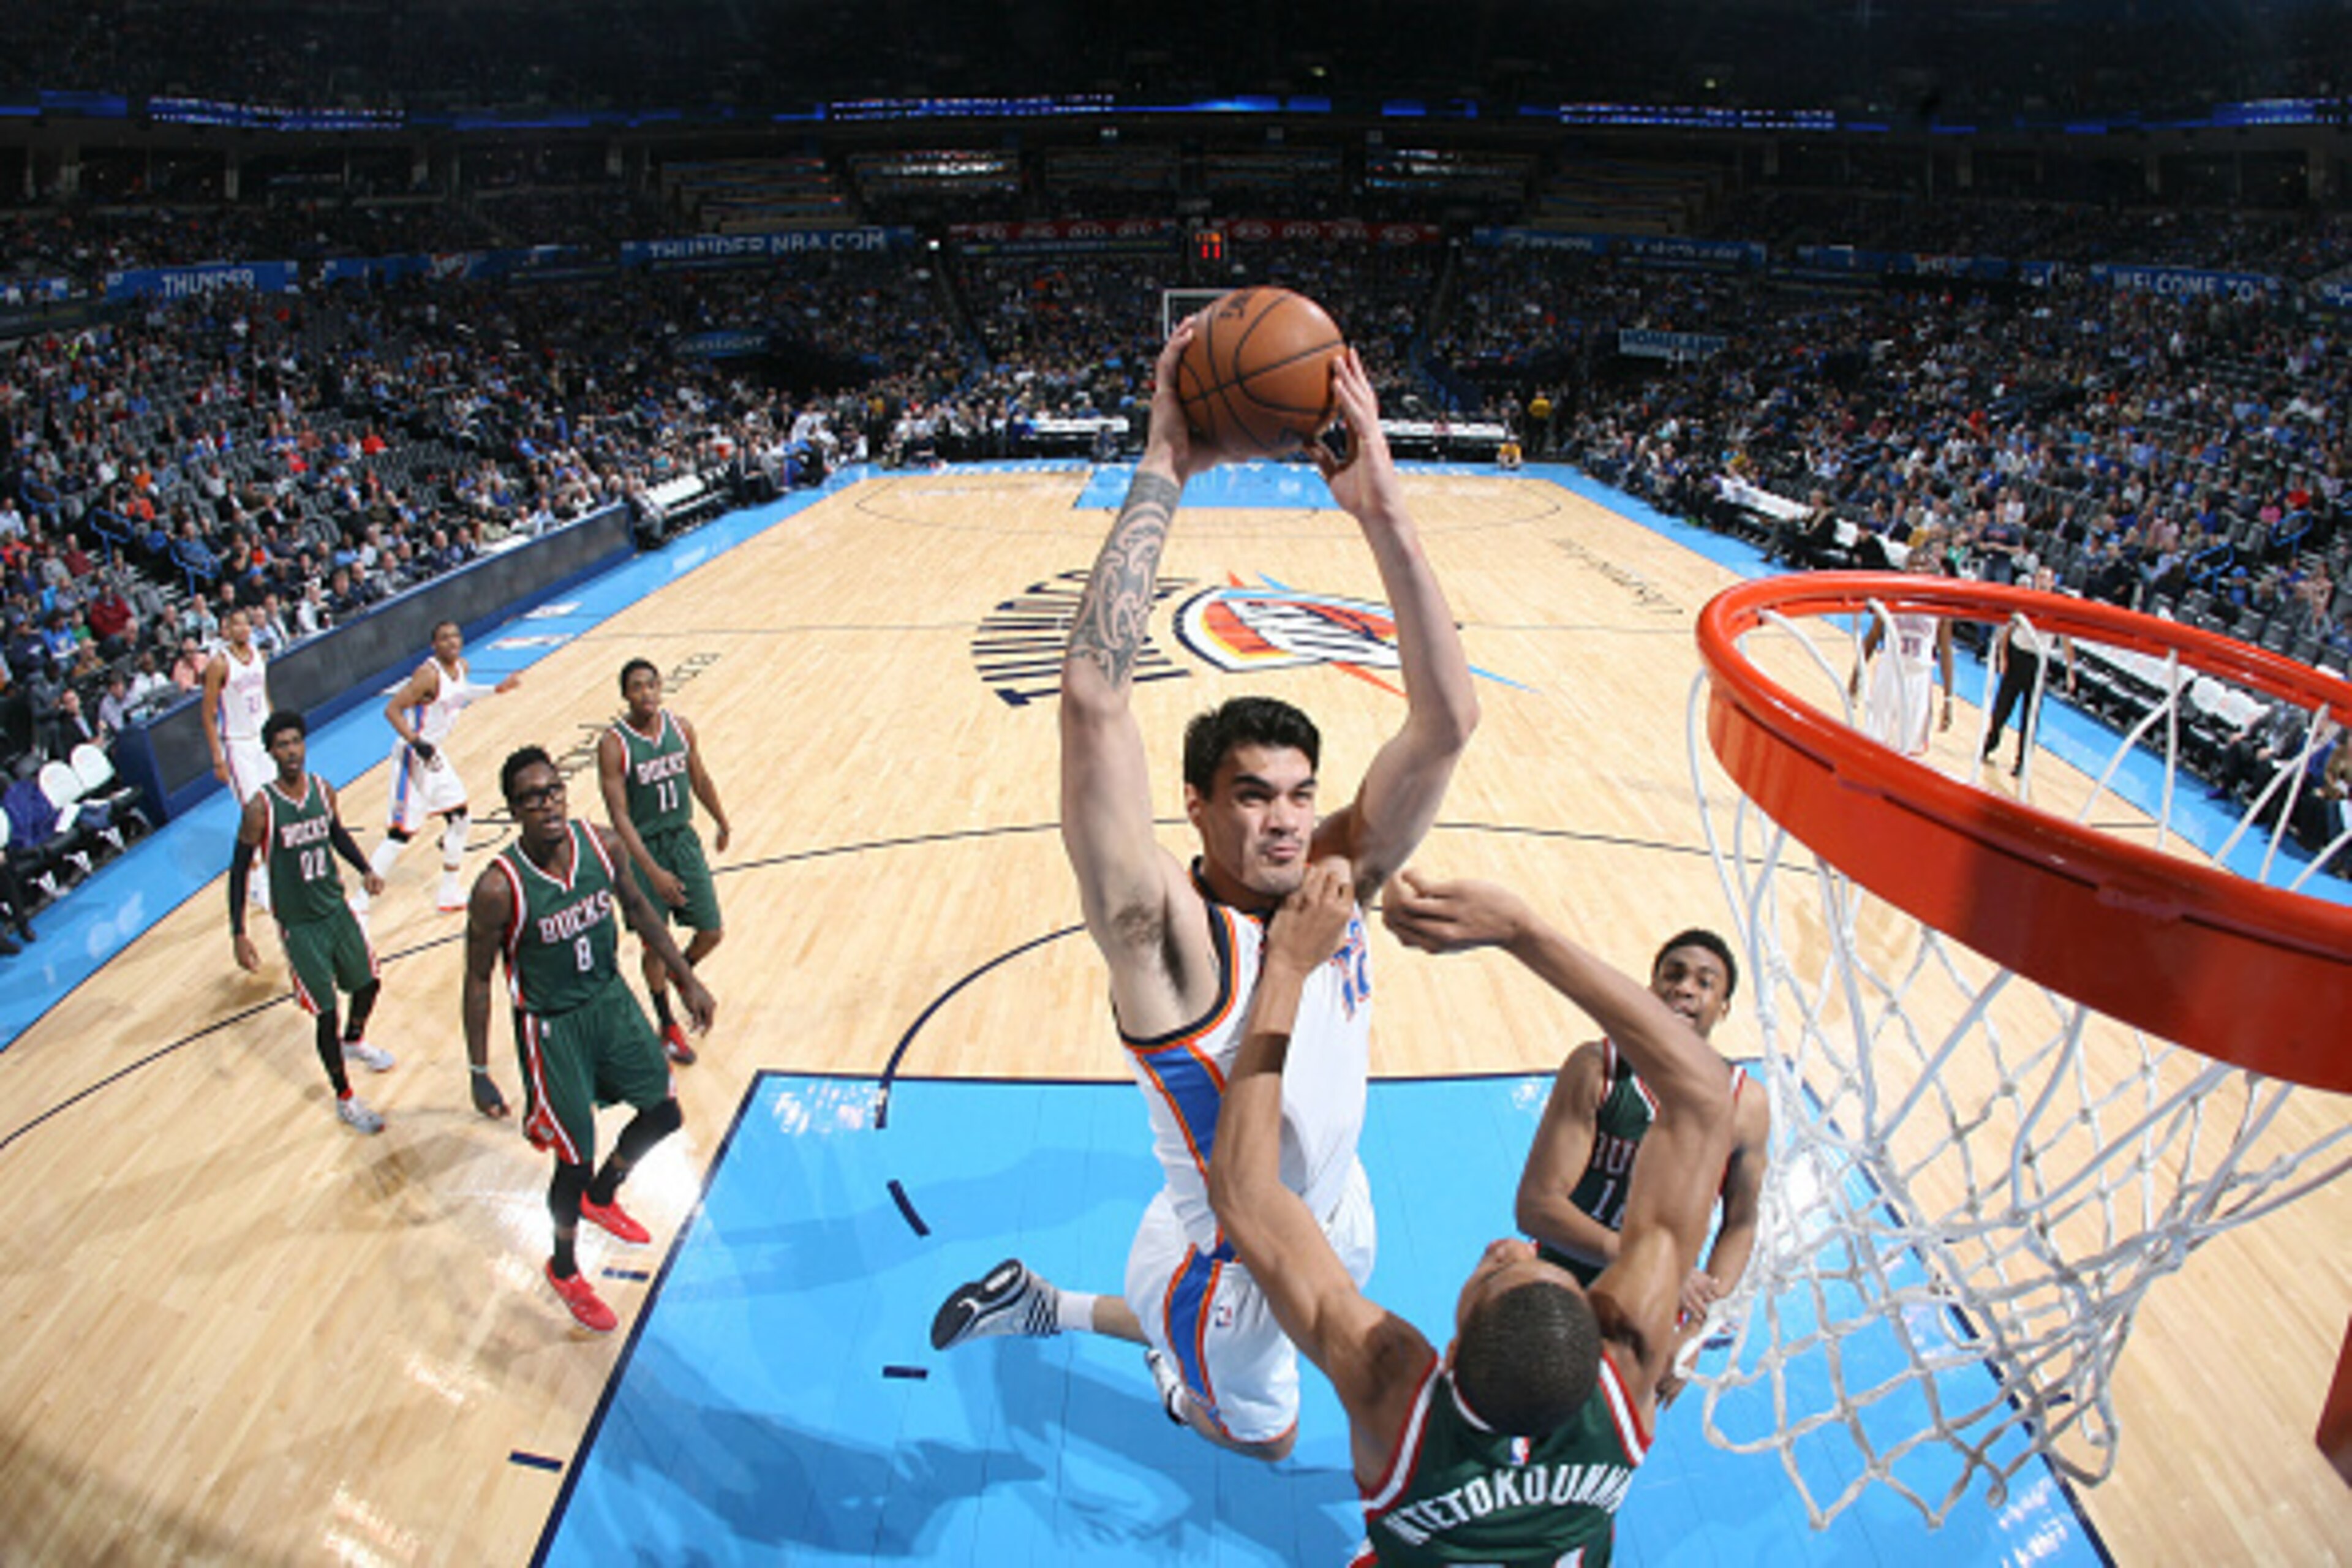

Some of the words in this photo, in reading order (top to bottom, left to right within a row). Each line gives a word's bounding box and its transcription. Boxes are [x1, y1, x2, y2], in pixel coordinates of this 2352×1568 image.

[161, 268, 255, 299] THUNDER
[636, 752, 687, 785] BUCKS
[656, 779, 679, 813] 11
[281, 815, 330, 849] BUCKS
[537, 888, 611, 944] BUCKS
[575, 935, 594, 972] 8
